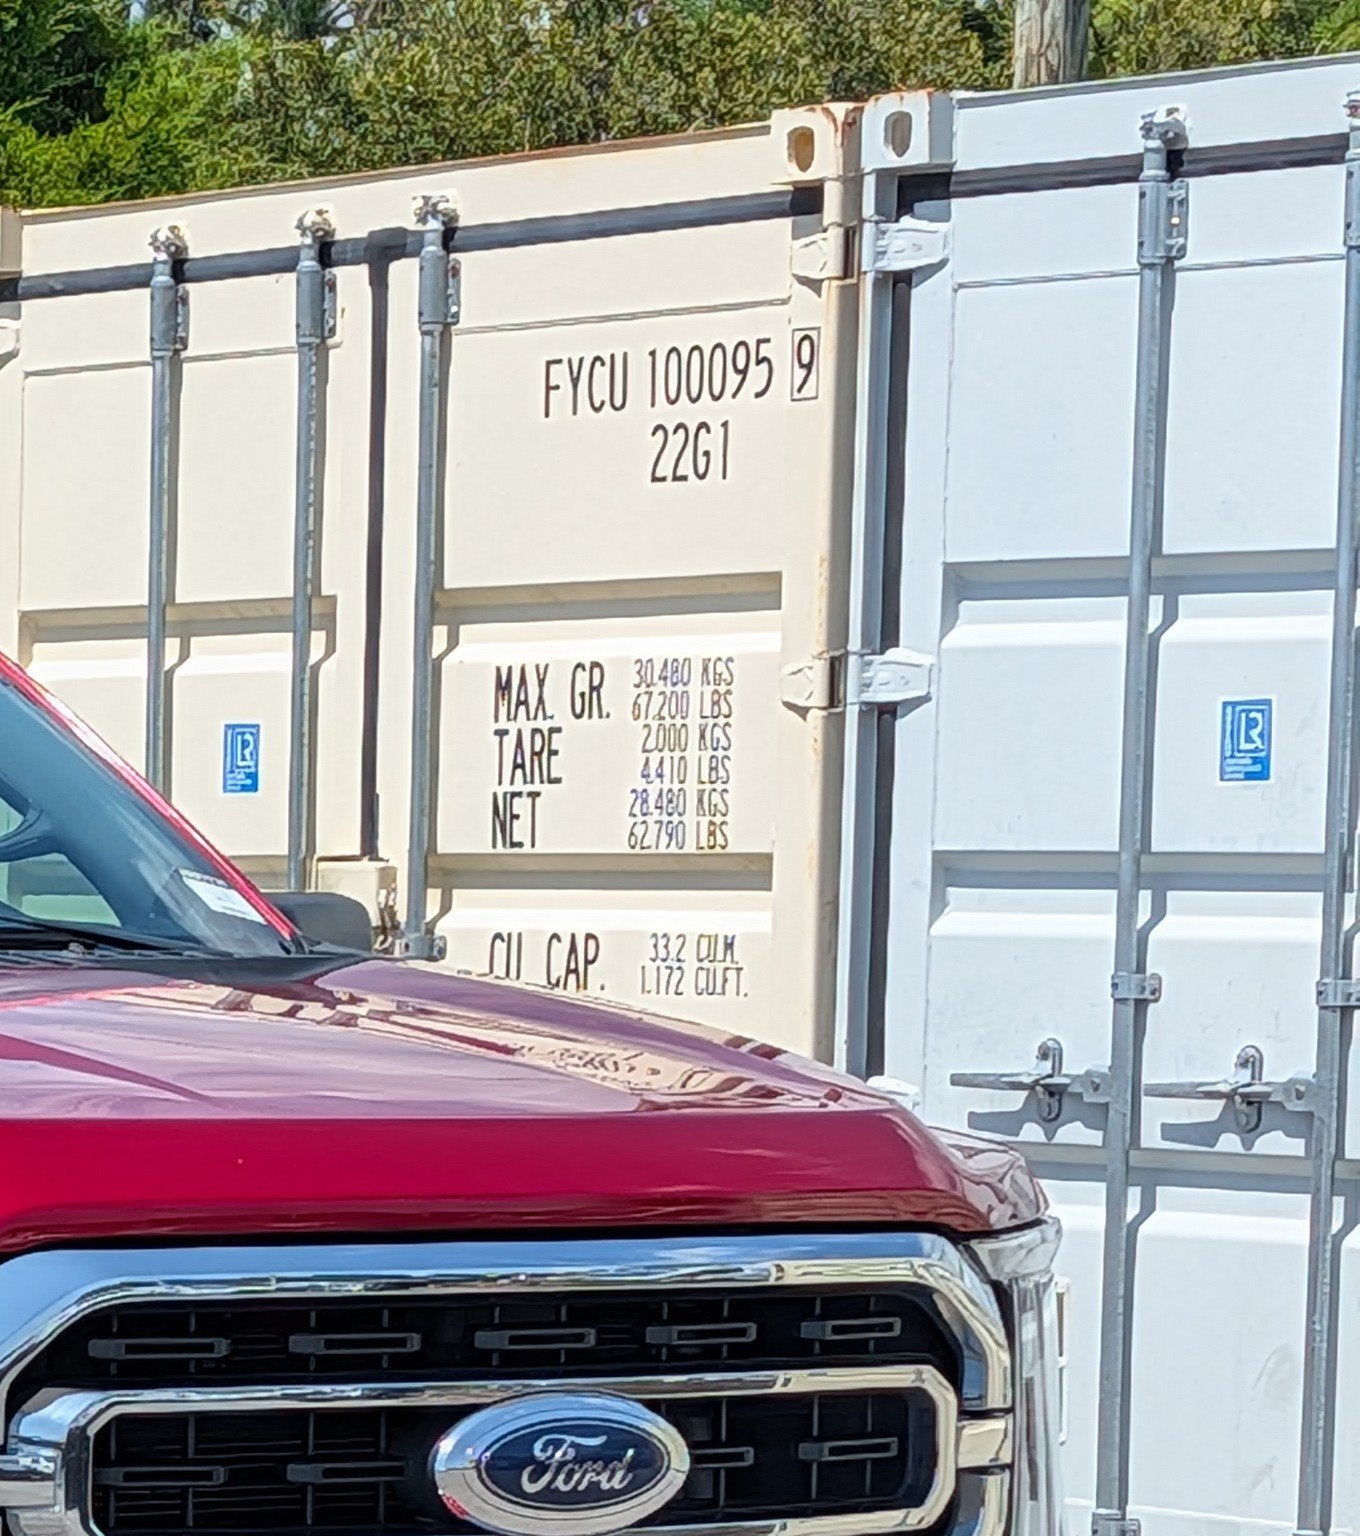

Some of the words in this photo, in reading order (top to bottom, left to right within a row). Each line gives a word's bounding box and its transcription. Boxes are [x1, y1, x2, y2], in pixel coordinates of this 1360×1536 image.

[544, 351, 628, 418] FYCU
[648, 337, 774, 408] 100095
[796, 333, 815, 394] 9
[650, 419, 730, 483] 22G1
[493, 663, 555, 723] MAX.
[570, 661, 611, 720] GR.
[700, 656, 734, 687] KGS
[699, 689, 733, 719] LBS
[493, 726, 563, 786] TARE
[698, 722, 732, 752] KGS
[697, 754, 731, 785] LBS
[491, 791, 542, 849] NET
[695, 788, 730, 818] KGS
[695, 819, 729, 850] LBS
[546, 931, 606, 992] CAP.
[521, 1434, 635, 1494] Ford
